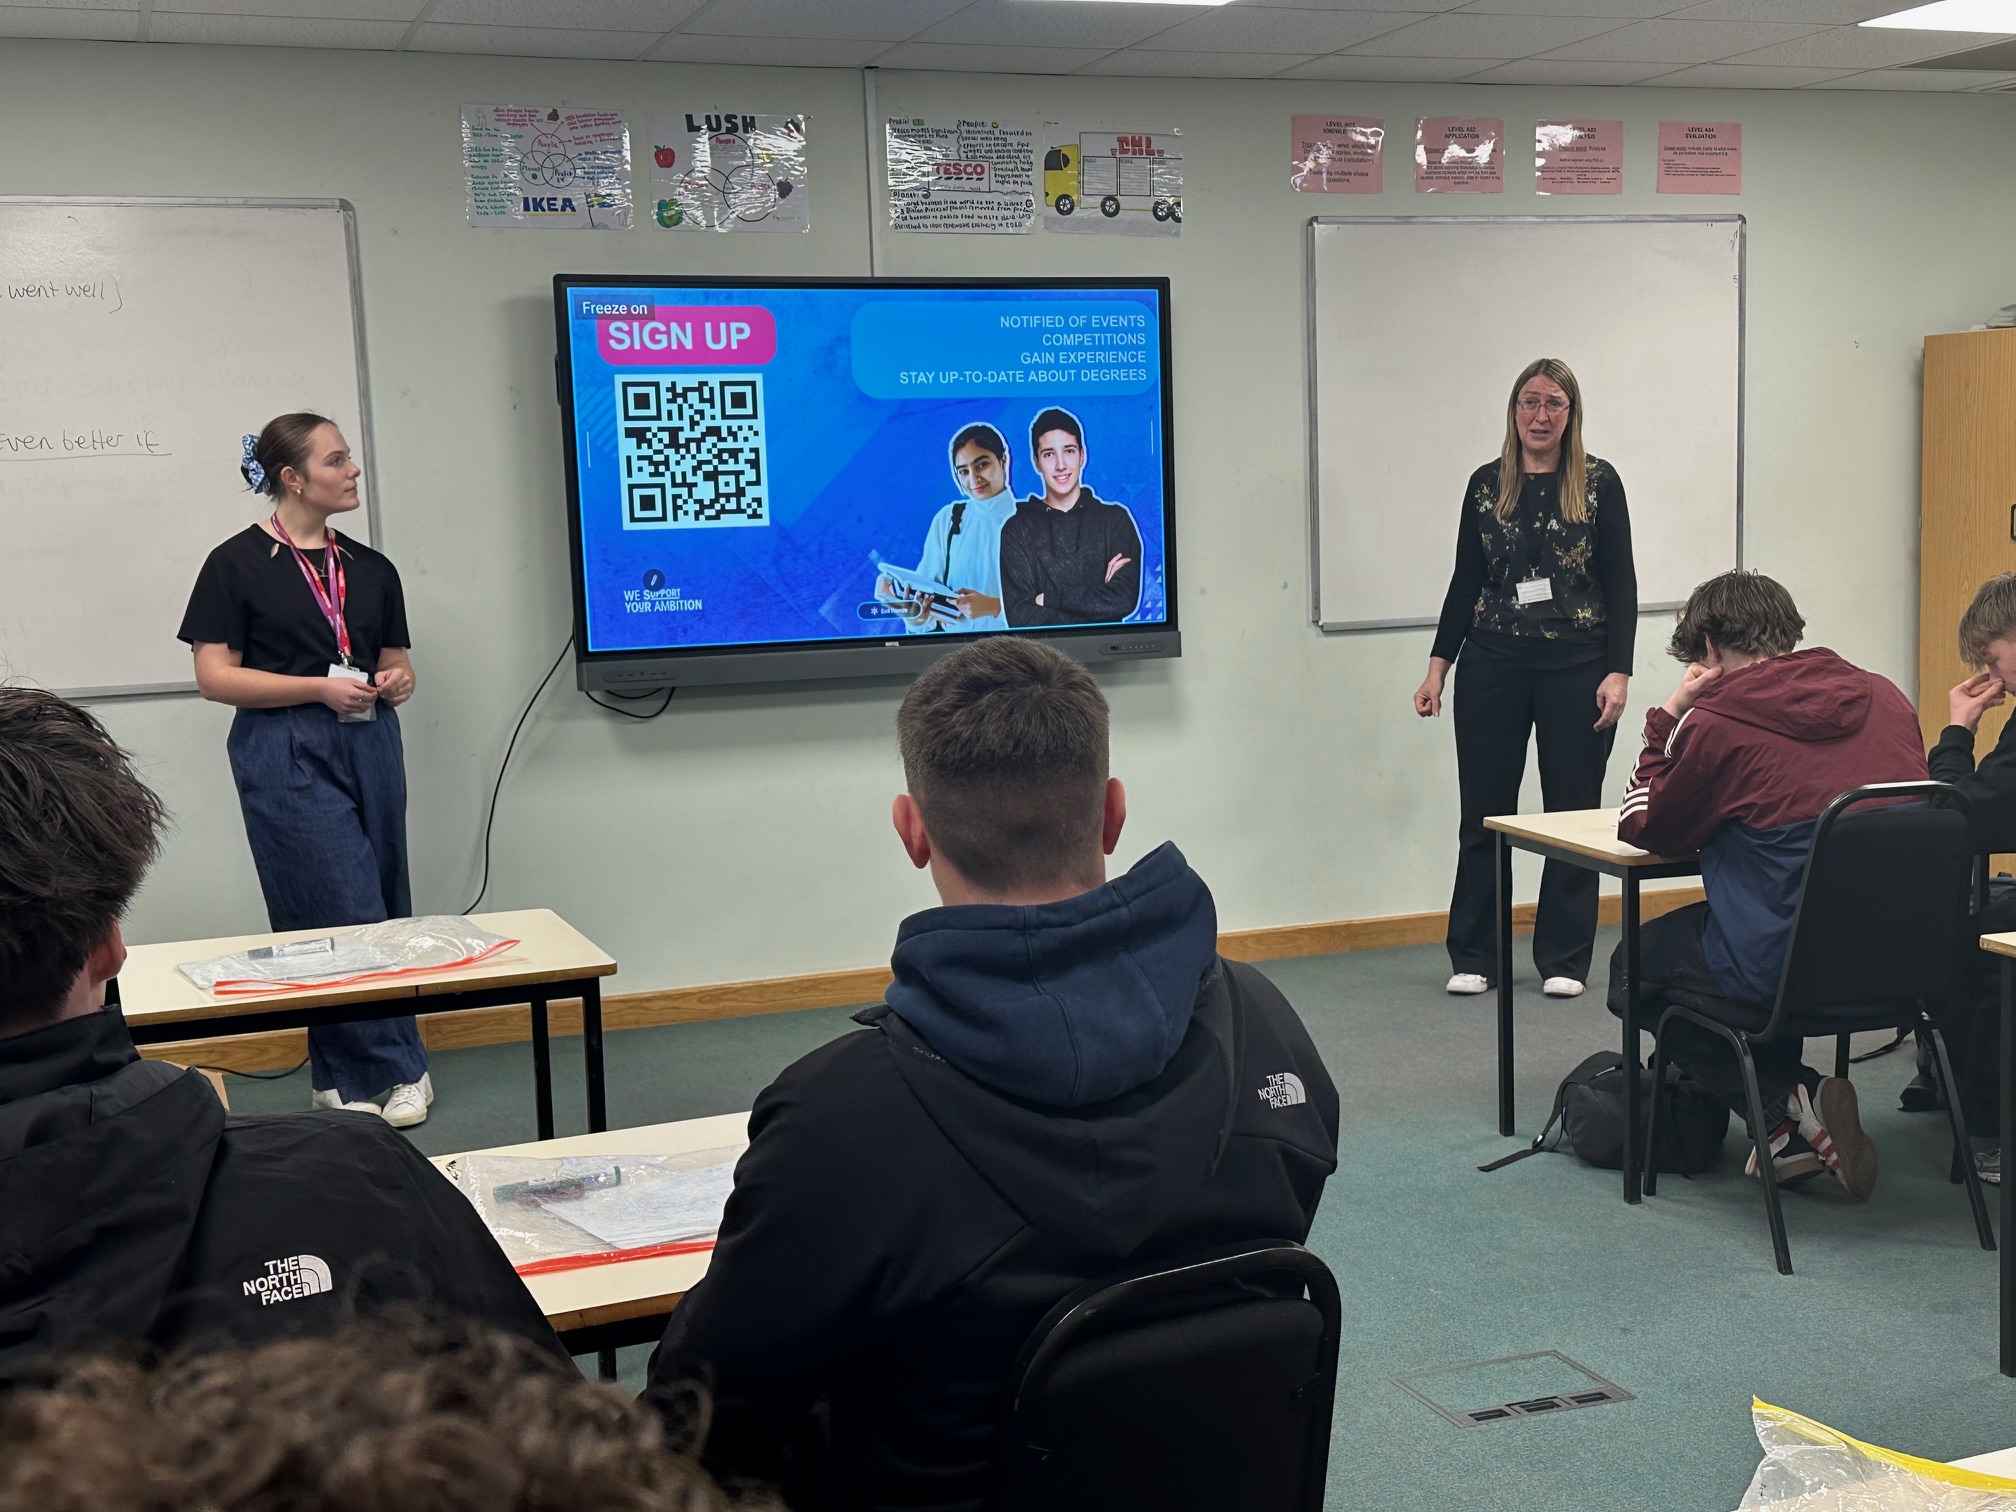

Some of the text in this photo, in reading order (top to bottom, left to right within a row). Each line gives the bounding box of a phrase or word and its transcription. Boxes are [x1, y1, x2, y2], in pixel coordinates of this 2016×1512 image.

[685, 113, 757, 134] LUSH
[538, 140, 559, 148] People
[1116, 135, 1156, 156] DHL
[932, 162, 985, 177] TESCO
[522, 196, 577, 213] IKEA
[8, 281, 60, 300] went
[582, 301, 648, 315] Freeze on
[1000, 315, 1146, 328] NOTIFIED OF EVENTS
[608, 321, 751, 350] SIGN UP
[1042, 333, 1146, 346] COMPETITIONS
[1020, 350, 1147, 365] GAIN EXPERIENCE
[899, 368, 1147, 384] STAY UP-TO-DATE ABOUT DEGREES
[63, 429, 123, 451] better
[624, 588, 681, 601] WE SUPPORT
[625, 599, 703, 614] YOUR AMBITION
[1266, 1073, 1284, 1086] THE
[1257, 1084, 1287, 1101] NORTH
[1270, 1095, 1288, 1109] FACE
[264, 1256, 299, 1275] THE
[242, 1270, 301, 1296] NORTH
[261, 1284, 304, 1306] FACE
